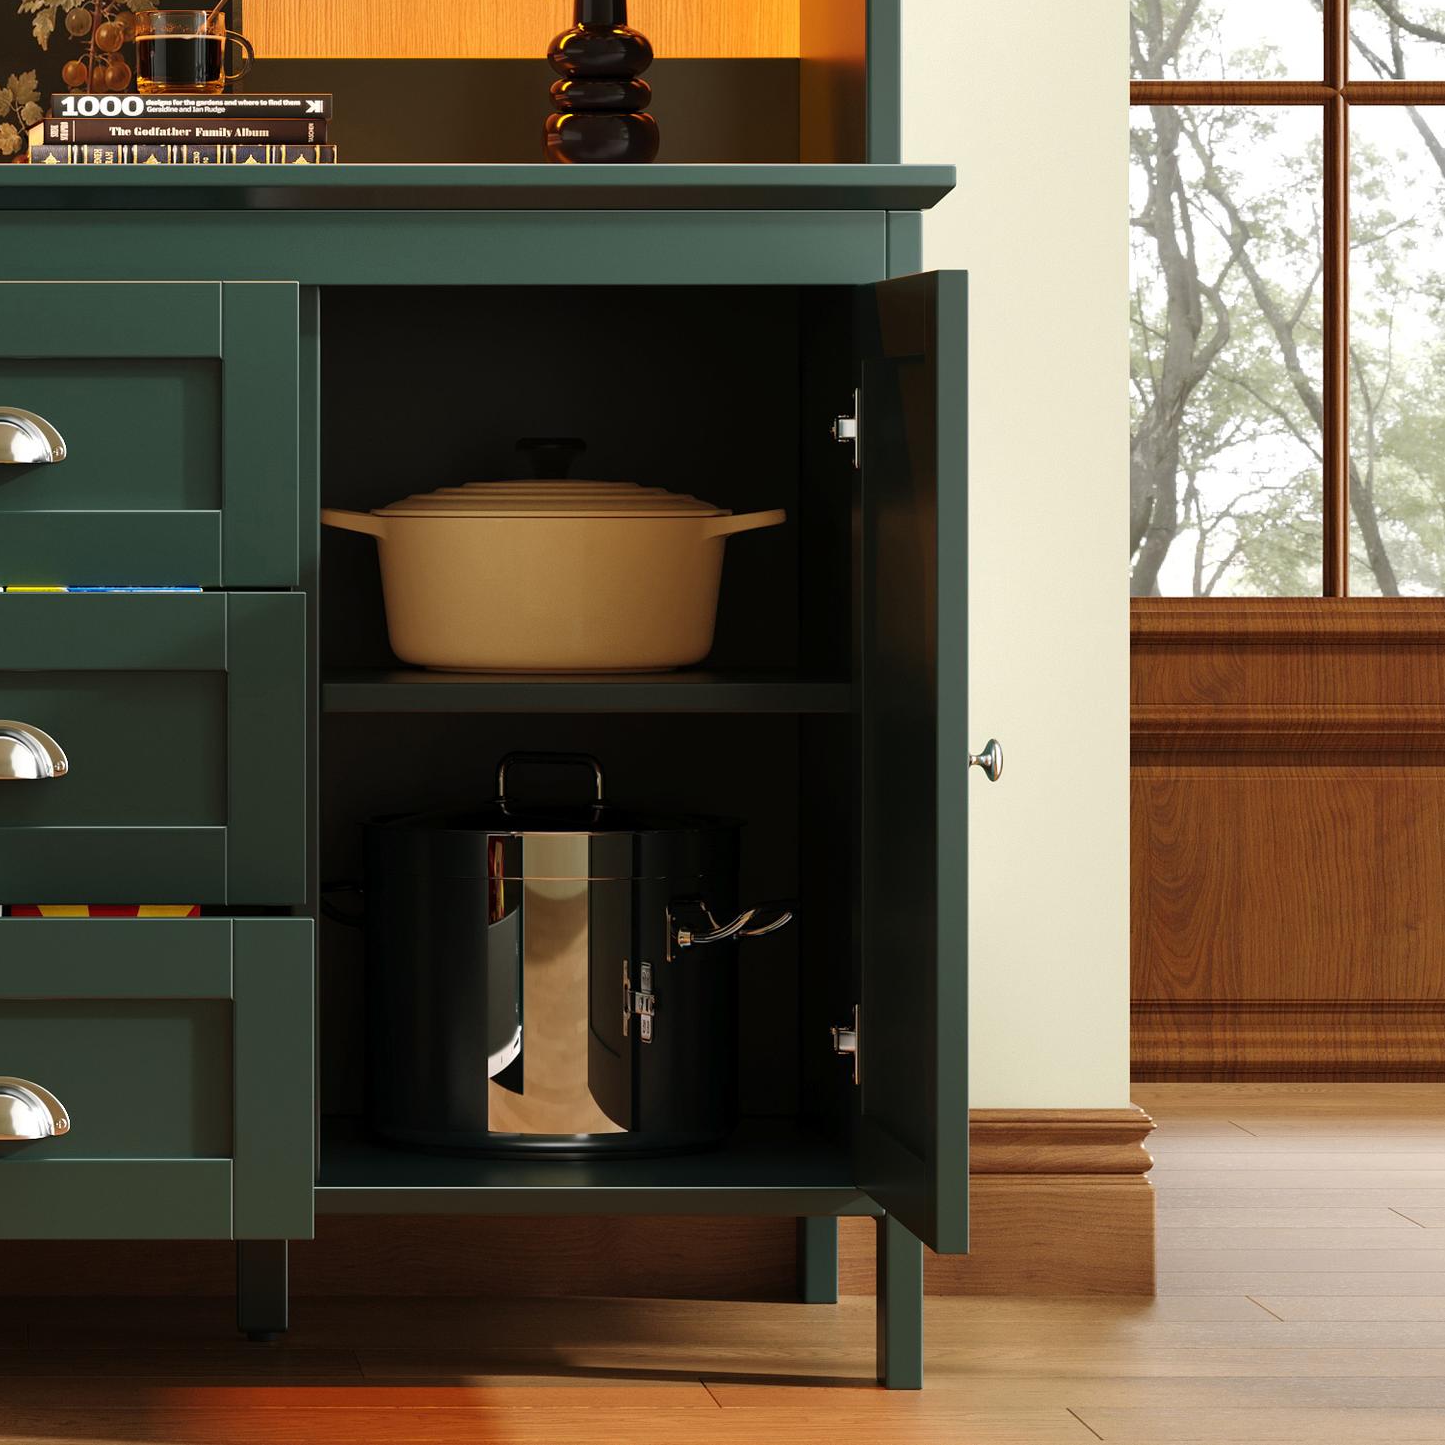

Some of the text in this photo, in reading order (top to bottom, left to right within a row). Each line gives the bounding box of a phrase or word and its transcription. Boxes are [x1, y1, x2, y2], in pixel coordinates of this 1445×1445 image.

[61, 96, 144, 116] 1000
[109, 126, 270, 138] The Godfather Family Album
